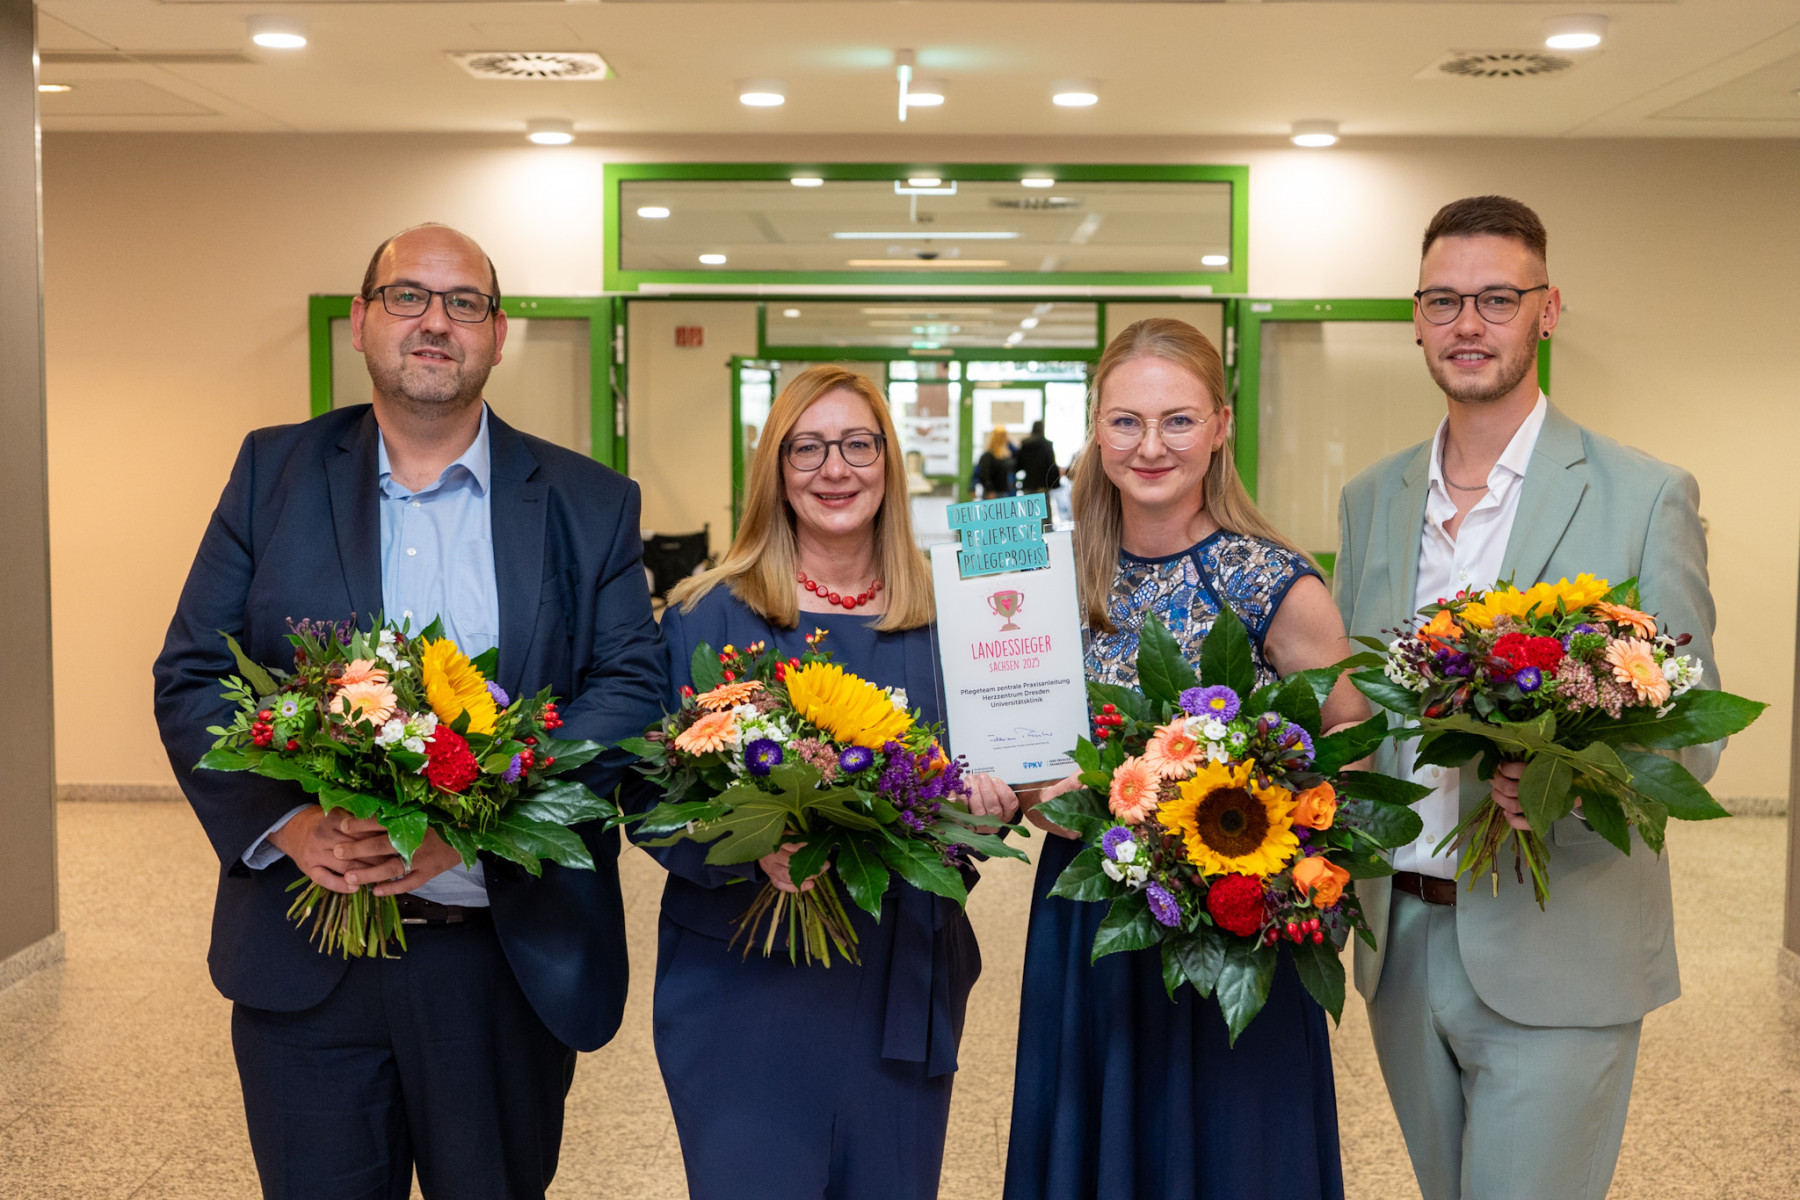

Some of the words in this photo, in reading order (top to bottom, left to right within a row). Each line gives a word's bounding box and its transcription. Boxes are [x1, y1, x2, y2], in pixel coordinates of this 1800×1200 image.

[953, 498, 1041, 523] DEUTSCHLANDS
[966, 524, 1037, 547] BELIEBTESTE
[971, 634, 1052, 660] LANDESSIEGER
[989, 660, 1020, 673] SACHSEN
[1023, 657, 1041, 669] 2025
[960, 686, 996, 696] Pflegeteam
[997, 683, 1022, 691] zentrale
[1023, 678, 1070, 688] Praxisanleitung
[982, 691, 1023, 701] Herzzentrum
[1024, 688, 1050, 696] Dresden
[990, 697, 1043, 708] Universitätsklinik
[1028, 761, 1043, 769] PKV
